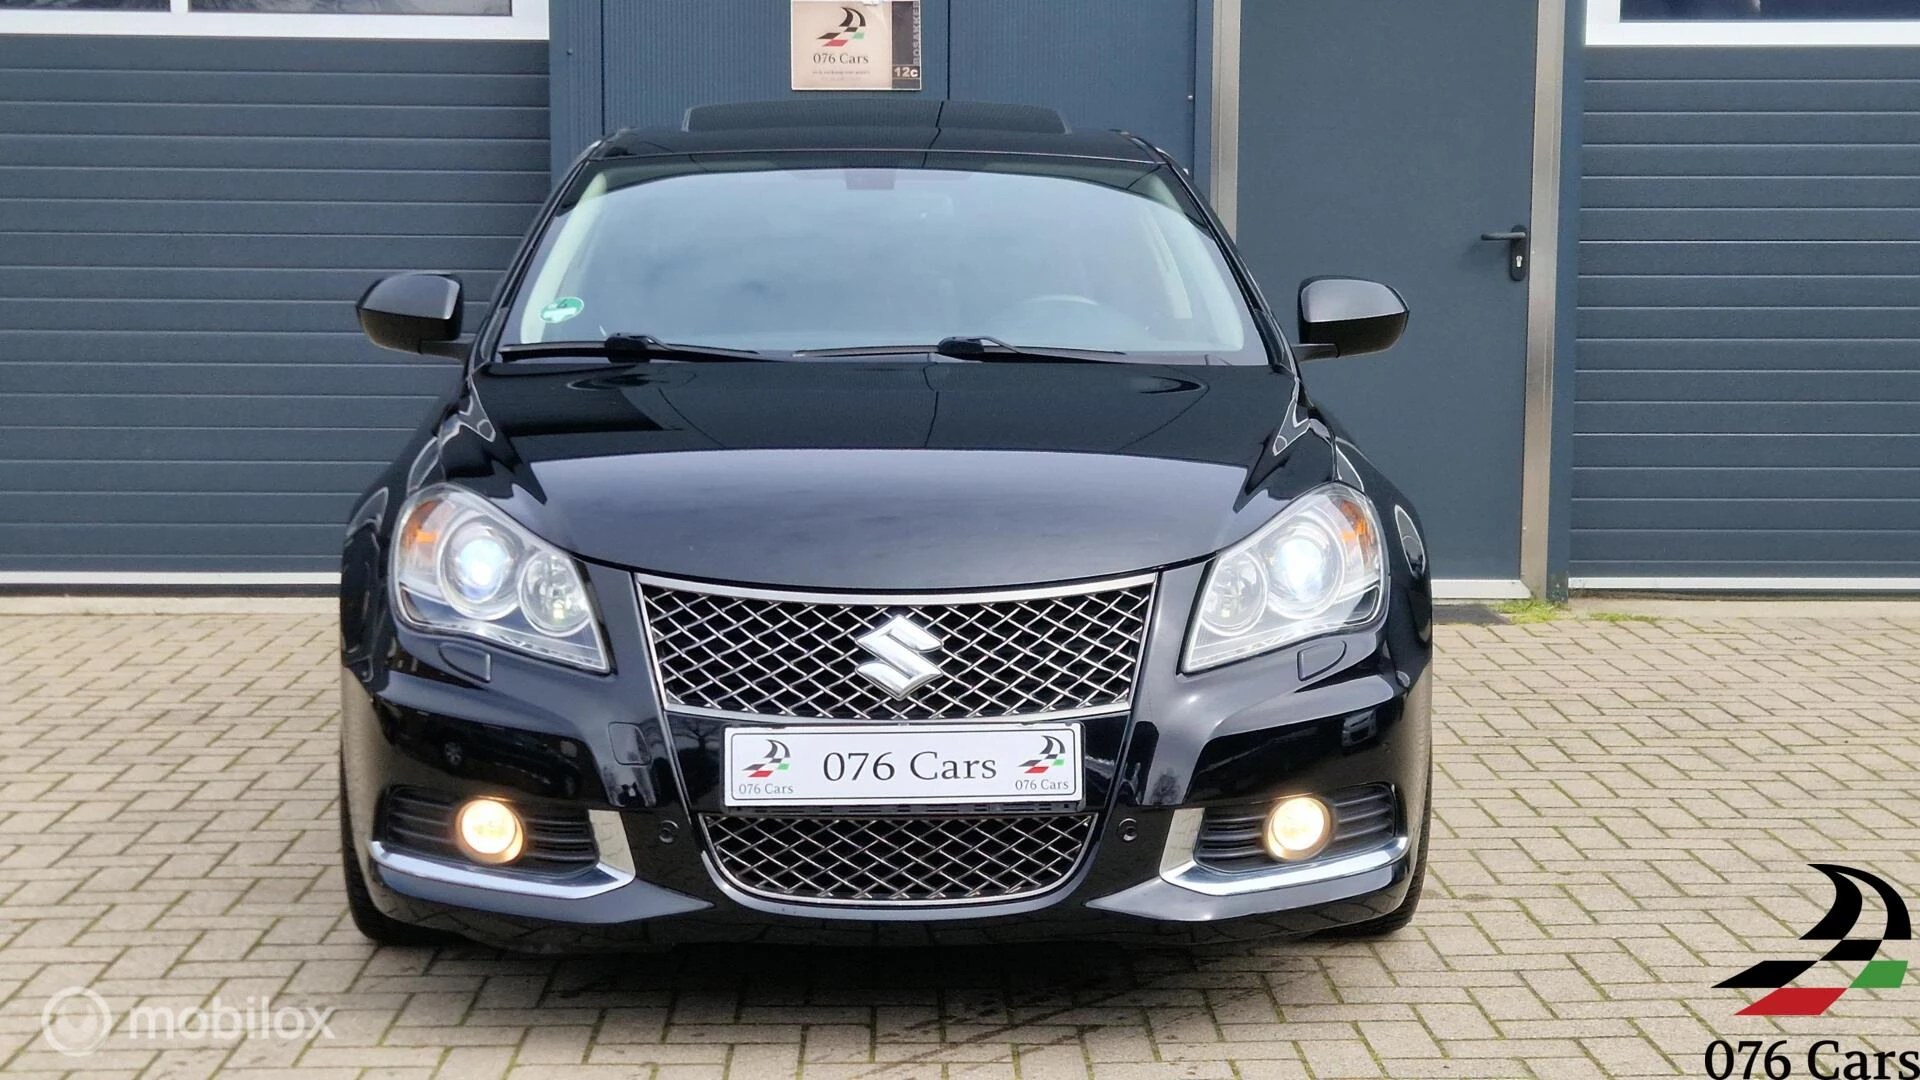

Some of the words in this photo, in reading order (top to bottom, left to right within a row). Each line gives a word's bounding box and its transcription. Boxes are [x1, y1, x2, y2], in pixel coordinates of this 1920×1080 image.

[813, 53, 836, 64] 076
[840, 53, 869, 64] Cars
[894, 67, 918, 78] 12c
[823, 752, 895, 781] 076
[909, 751, 997, 780] Cars
[738, 783, 761, 795] 076
[764, 783, 794, 794] Cars
[1015, 779, 1037, 791] 076
[1040, 778, 1069, 790] Cars
